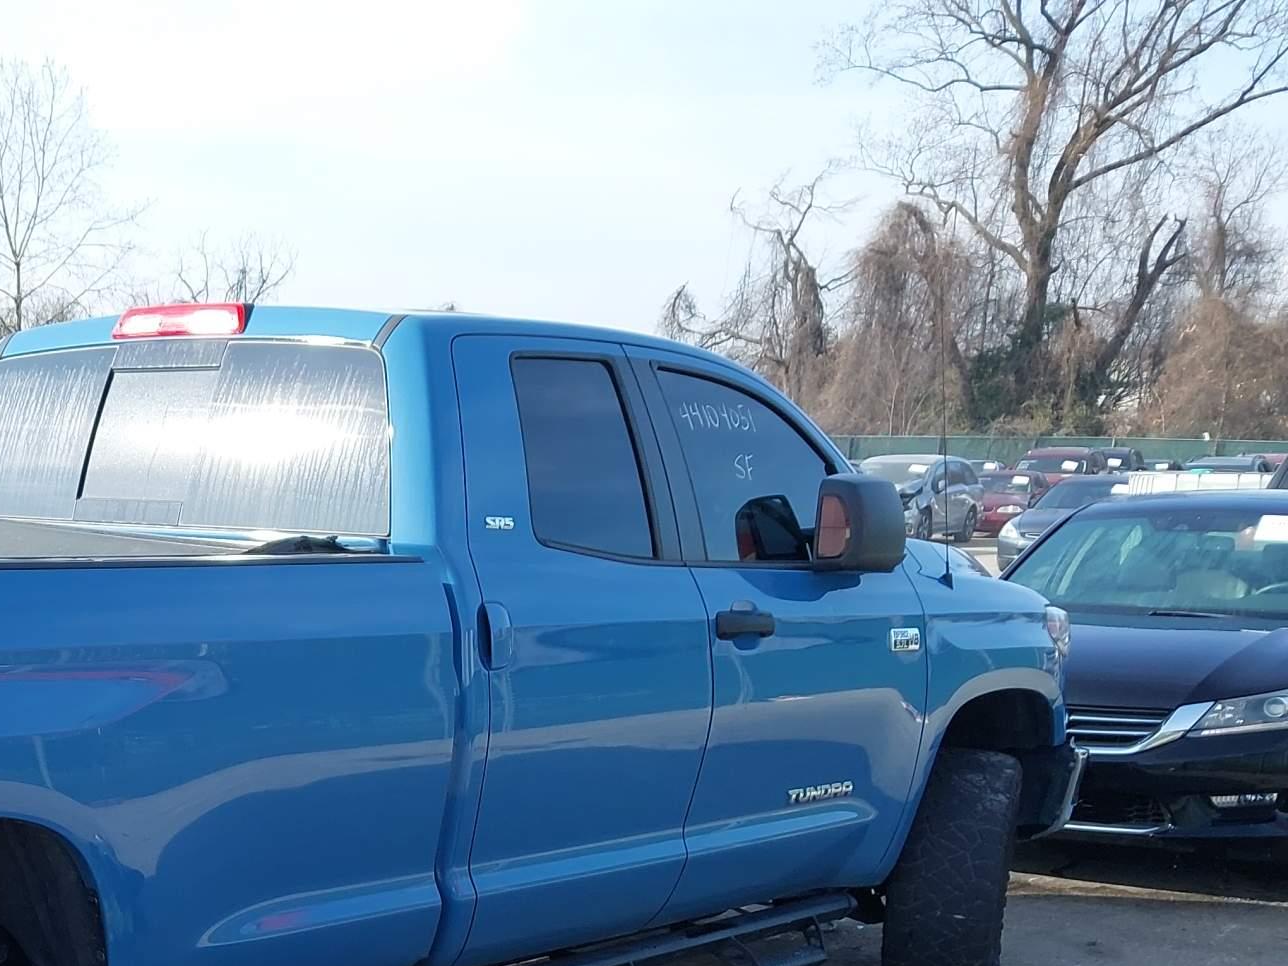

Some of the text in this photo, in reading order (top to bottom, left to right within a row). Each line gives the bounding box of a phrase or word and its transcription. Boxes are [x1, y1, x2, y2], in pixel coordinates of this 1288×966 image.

[680, 401, 757, 433] 44104051
[734, 453, 753, 481] SF
[485, 516, 514, 530] SR5
[788, 781, 854, 804] TUNDRA
